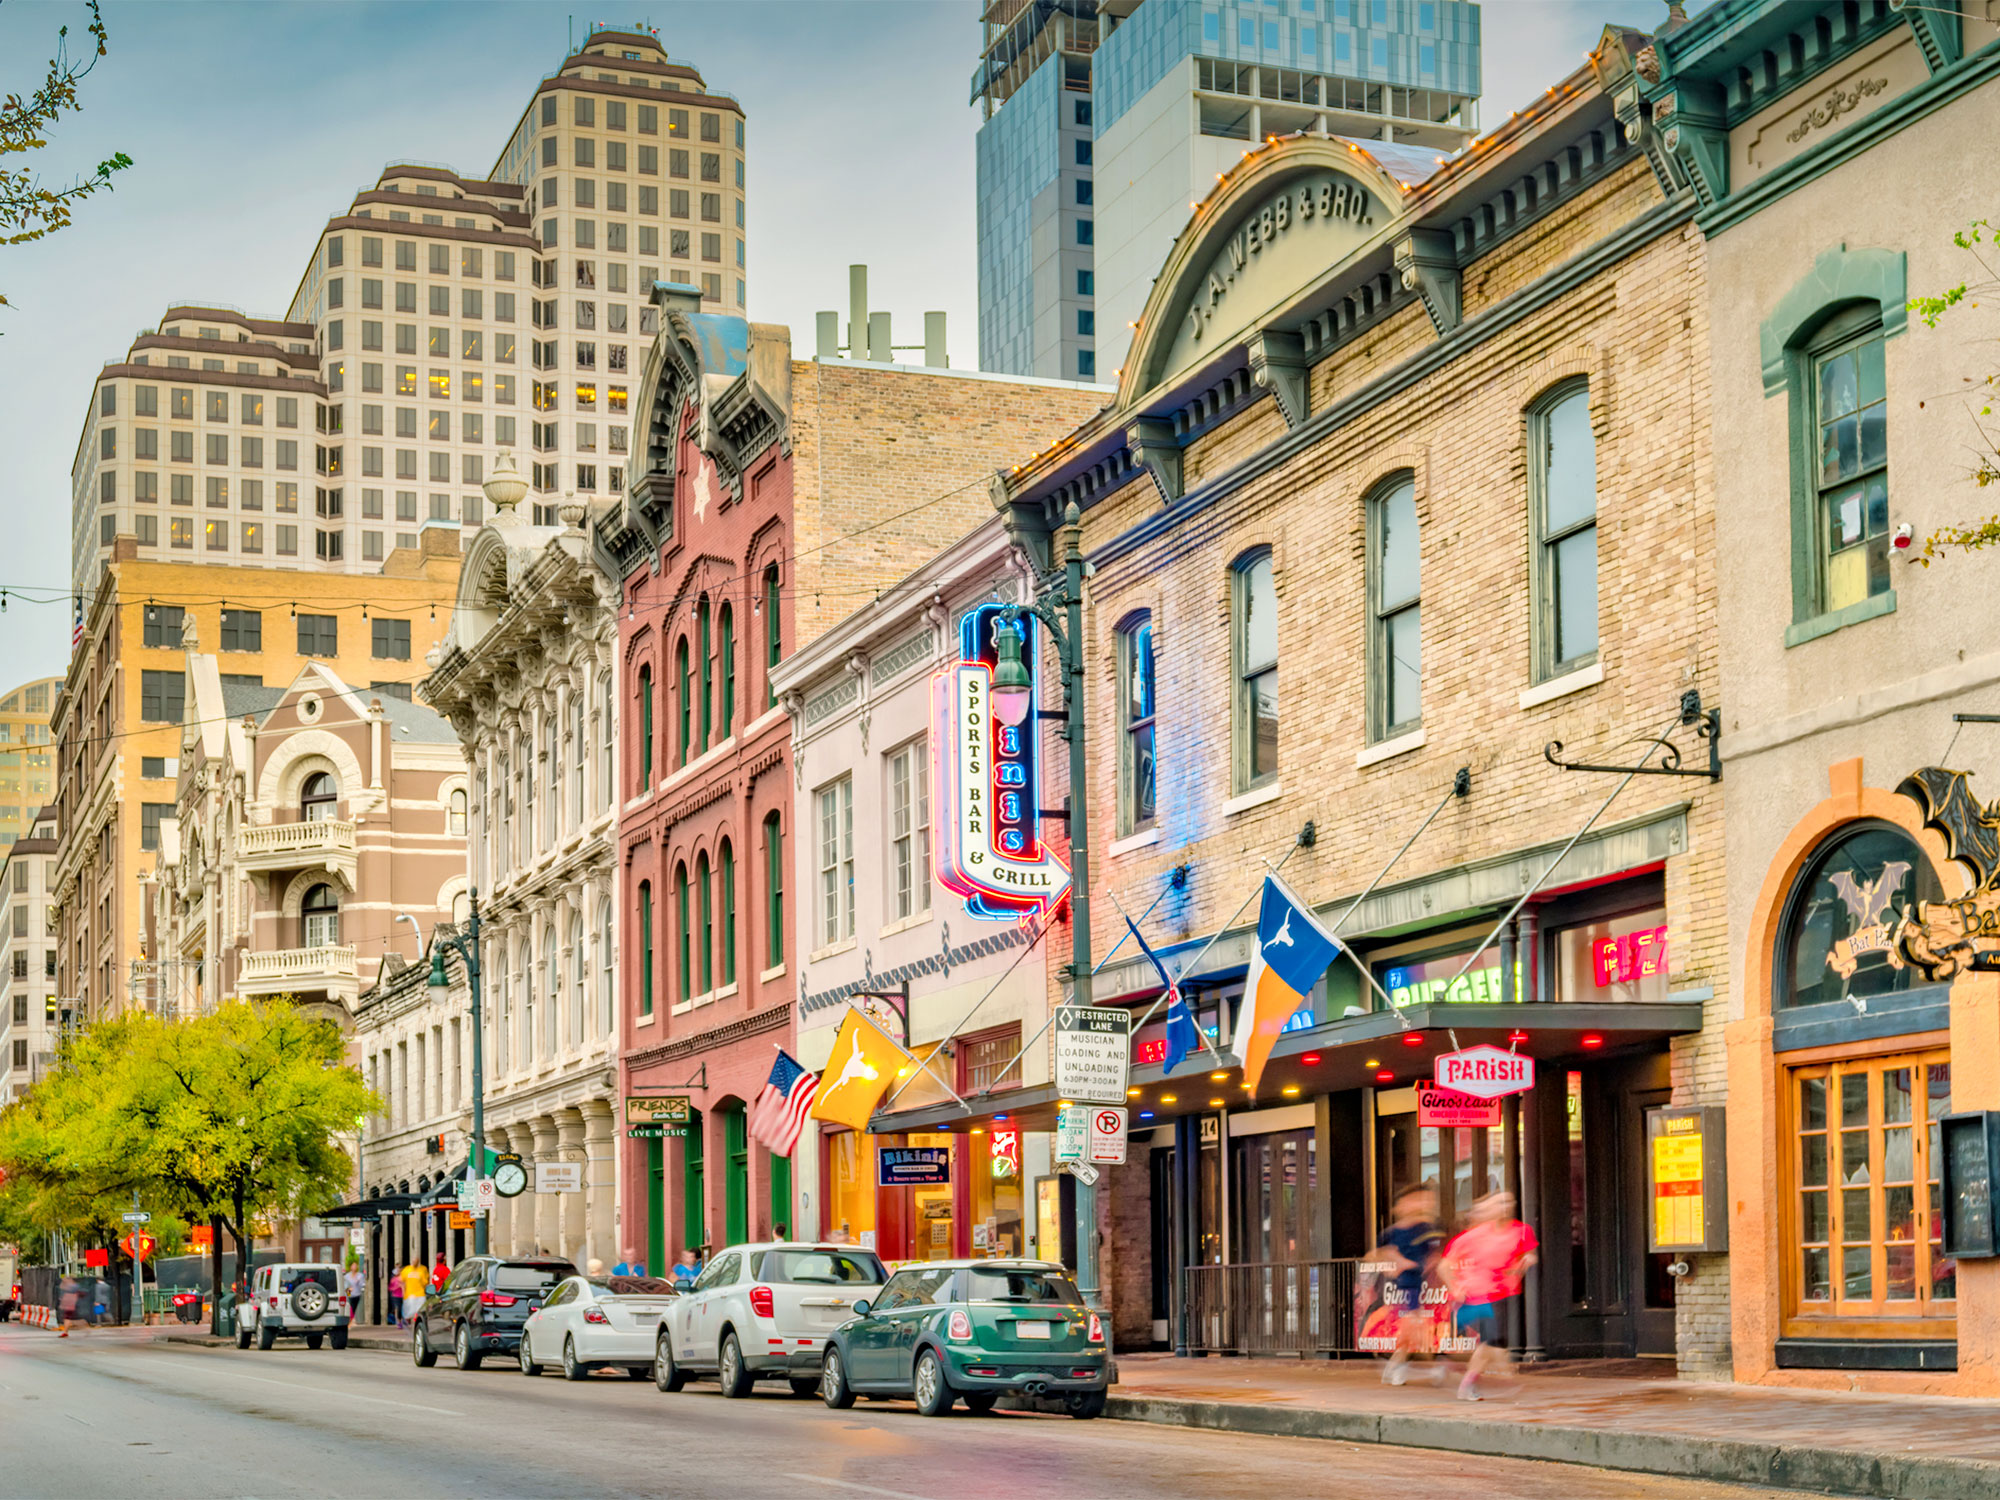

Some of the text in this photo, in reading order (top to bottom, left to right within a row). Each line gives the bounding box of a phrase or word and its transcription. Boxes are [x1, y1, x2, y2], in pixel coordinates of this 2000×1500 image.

[1299, 186, 1315, 219] &
[1320, 182, 1373, 225] BRO.
[968, 680, 1052, 886] SPORTS BAR & GRILL
[1848, 935, 1870, 955] Bat
[1075, 1010, 1128, 1022] RESTRICTED
[1090, 1021, 1113, 1031] LANE
[1071, 1034, 1114, 1045] MUSICIAN
[1058, 1048, 1125, 1060] LOADING AND
[1065, 1062, 1119, 1074] UNLOADING
[1058, 1087, 1123, 1099] PERMIT REQUIRED
[630, 1100, 687, 1112] FRIENDS
[1422, 1093, 1463, 1109] Gino's
[655, 1129, 687, 1137] MUSIC
[883, 1149, 947, 1166] Bikinis
[1418, 1281, 1449, 1305] East
[1358, 1336, 1398, 1350] CARRYOUT
[1440, 1336, 1477, 1351] DELIVERY
